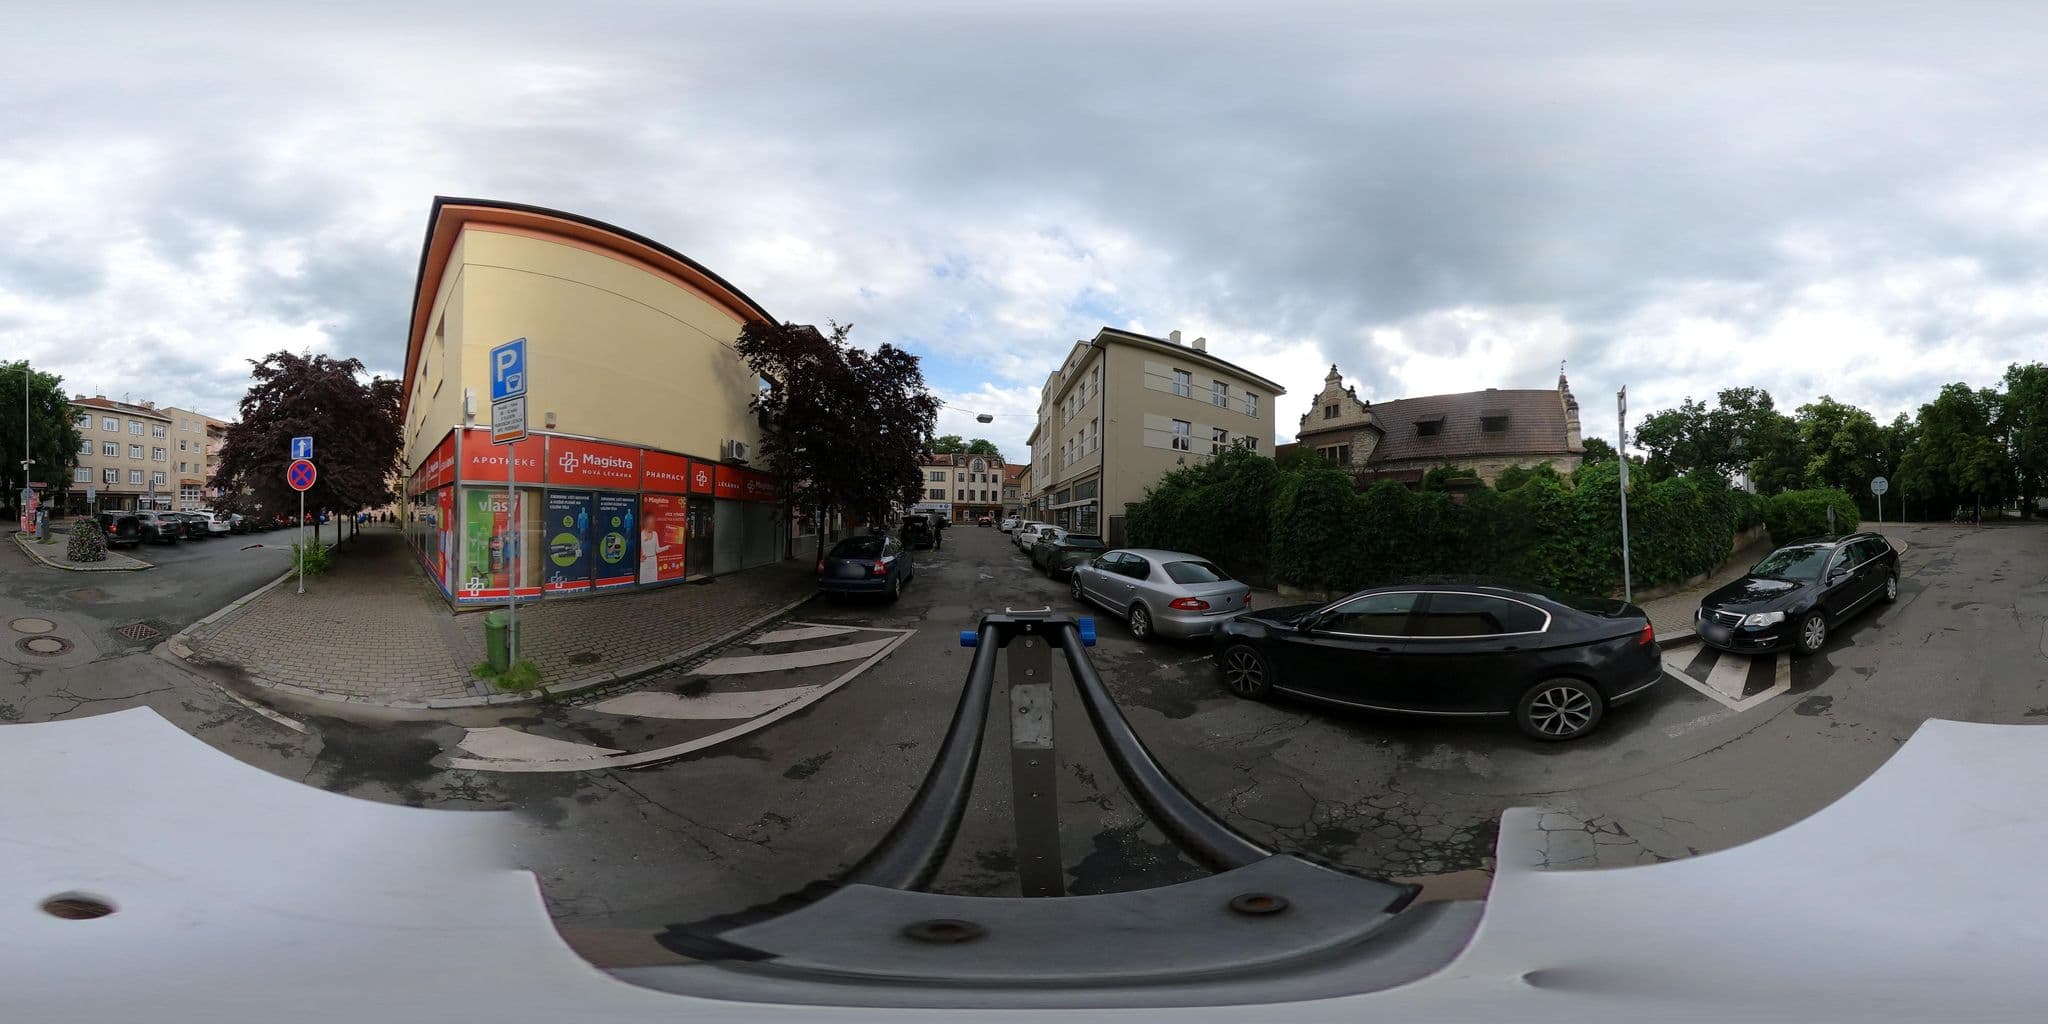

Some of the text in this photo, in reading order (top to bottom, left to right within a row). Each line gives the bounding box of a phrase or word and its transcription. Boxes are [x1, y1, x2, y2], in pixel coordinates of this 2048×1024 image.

[497, 349, 518, 382] P
[582, 453, 633, 469] Magistra
[646, 470, 685, 481] PHARMACY
